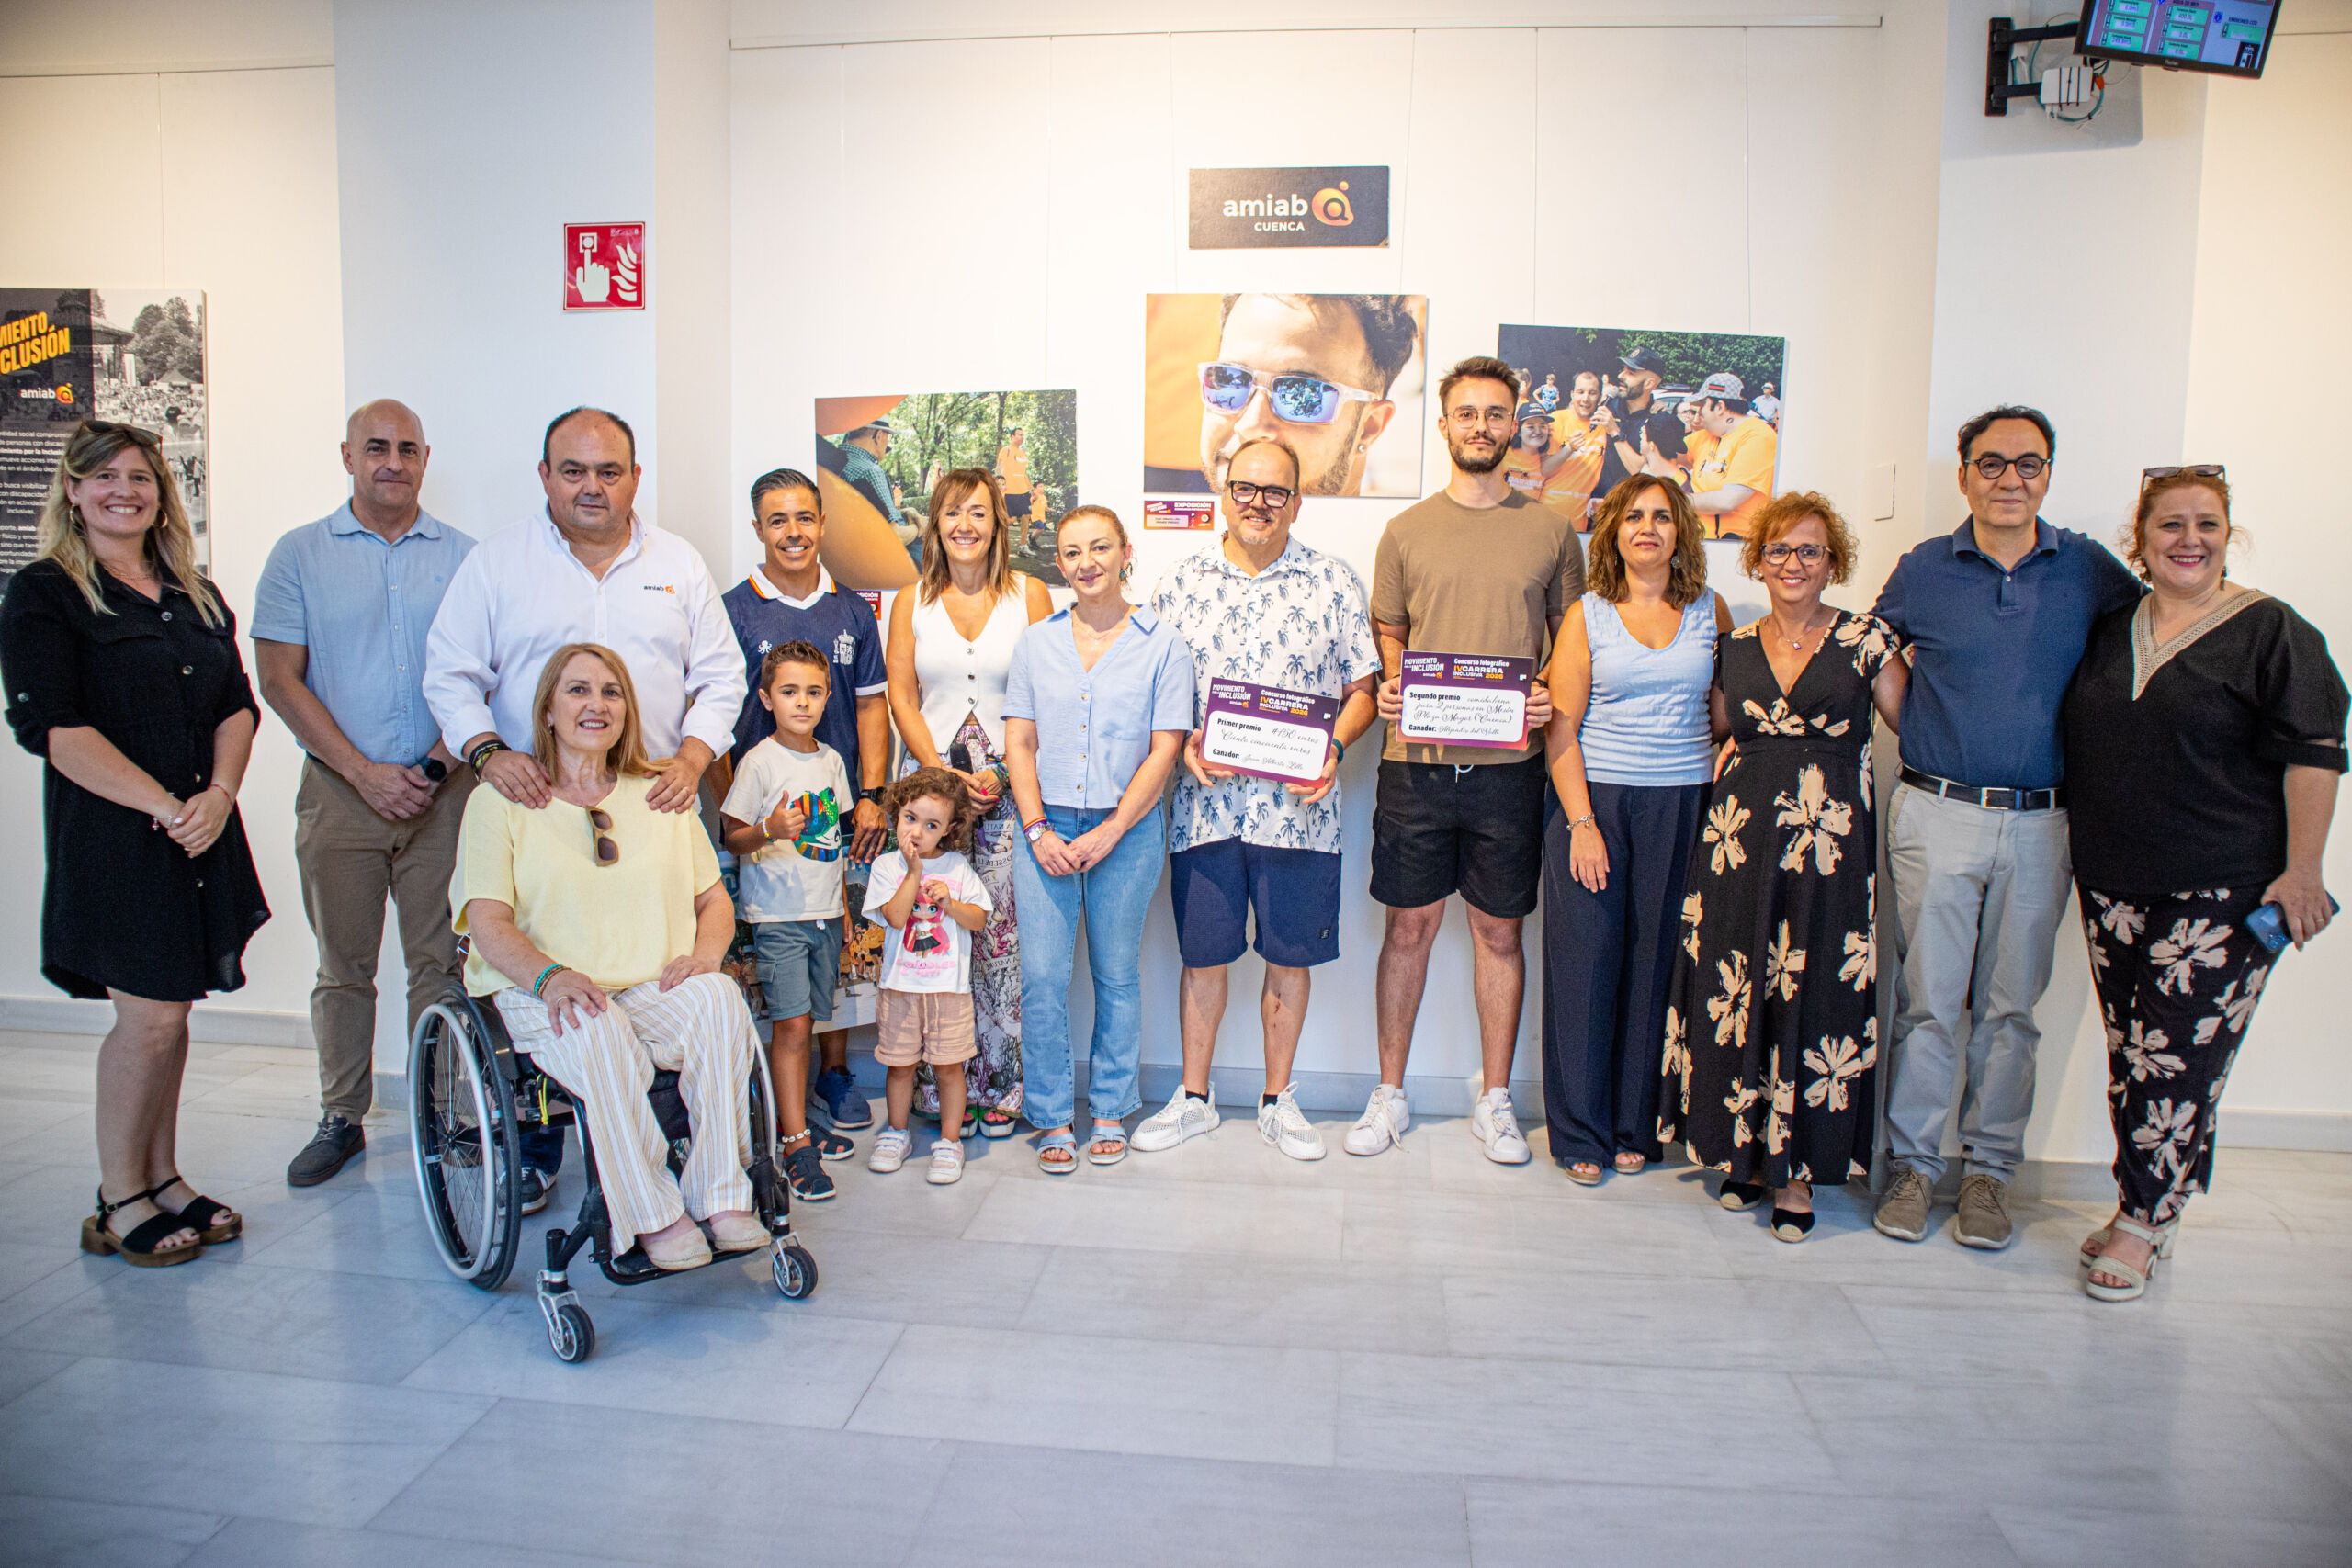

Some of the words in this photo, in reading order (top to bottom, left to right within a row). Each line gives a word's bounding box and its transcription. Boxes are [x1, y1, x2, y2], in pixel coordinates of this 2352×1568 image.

[1223, 194, 1308, 217] amiab
[1254, 221, 1305, 231] CUENCA
[20, 387, 55, 399] amiab
[1411, 662, 1444, 672] INCLUSIÓN
[1453, 658, 1479, 666] Concurso
[1479, 659, 1510, 668] fotográfico
[1218, 690, 1251, 701] INCLUSIÓN
[1261, 689, 1286, 699] Concurso
[1409, 692, 1437, 701] Segundo
[1438, 693, 1461, 702] premio
[1217, 718, 1238, 728] Primer
[1238, 723, 1261, 732] premio
[1408, 724, 1437, 732] Ganador:
[1213, 748, 1240, 760] Ganador:
